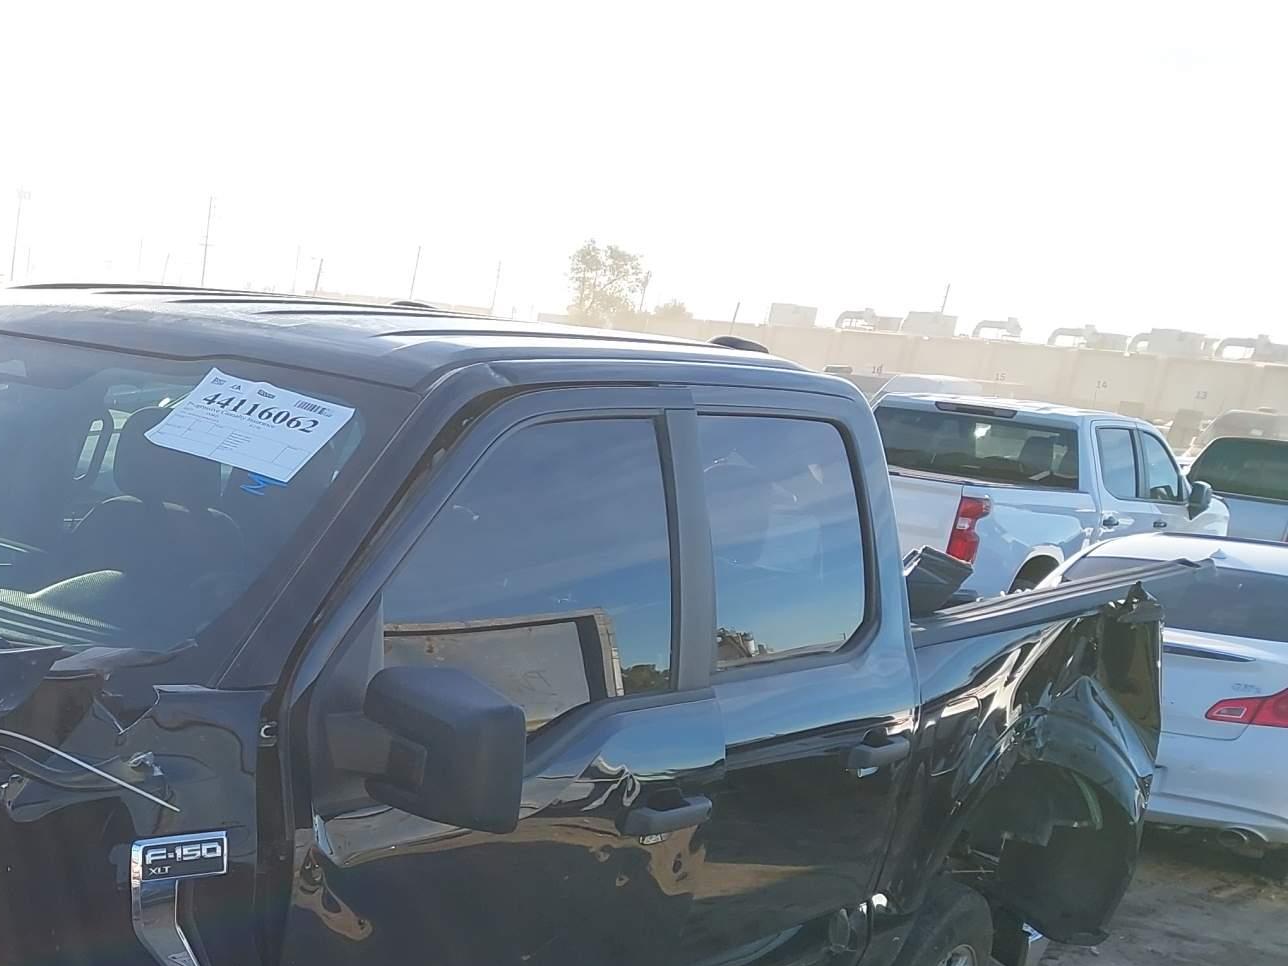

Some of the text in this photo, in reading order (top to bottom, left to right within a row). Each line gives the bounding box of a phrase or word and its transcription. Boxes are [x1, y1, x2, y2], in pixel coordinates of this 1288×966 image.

[202, 392, 319, 434] 44116062
[145, 842, 222, 865] F-150
[148, 865, 171, 876] XLT
